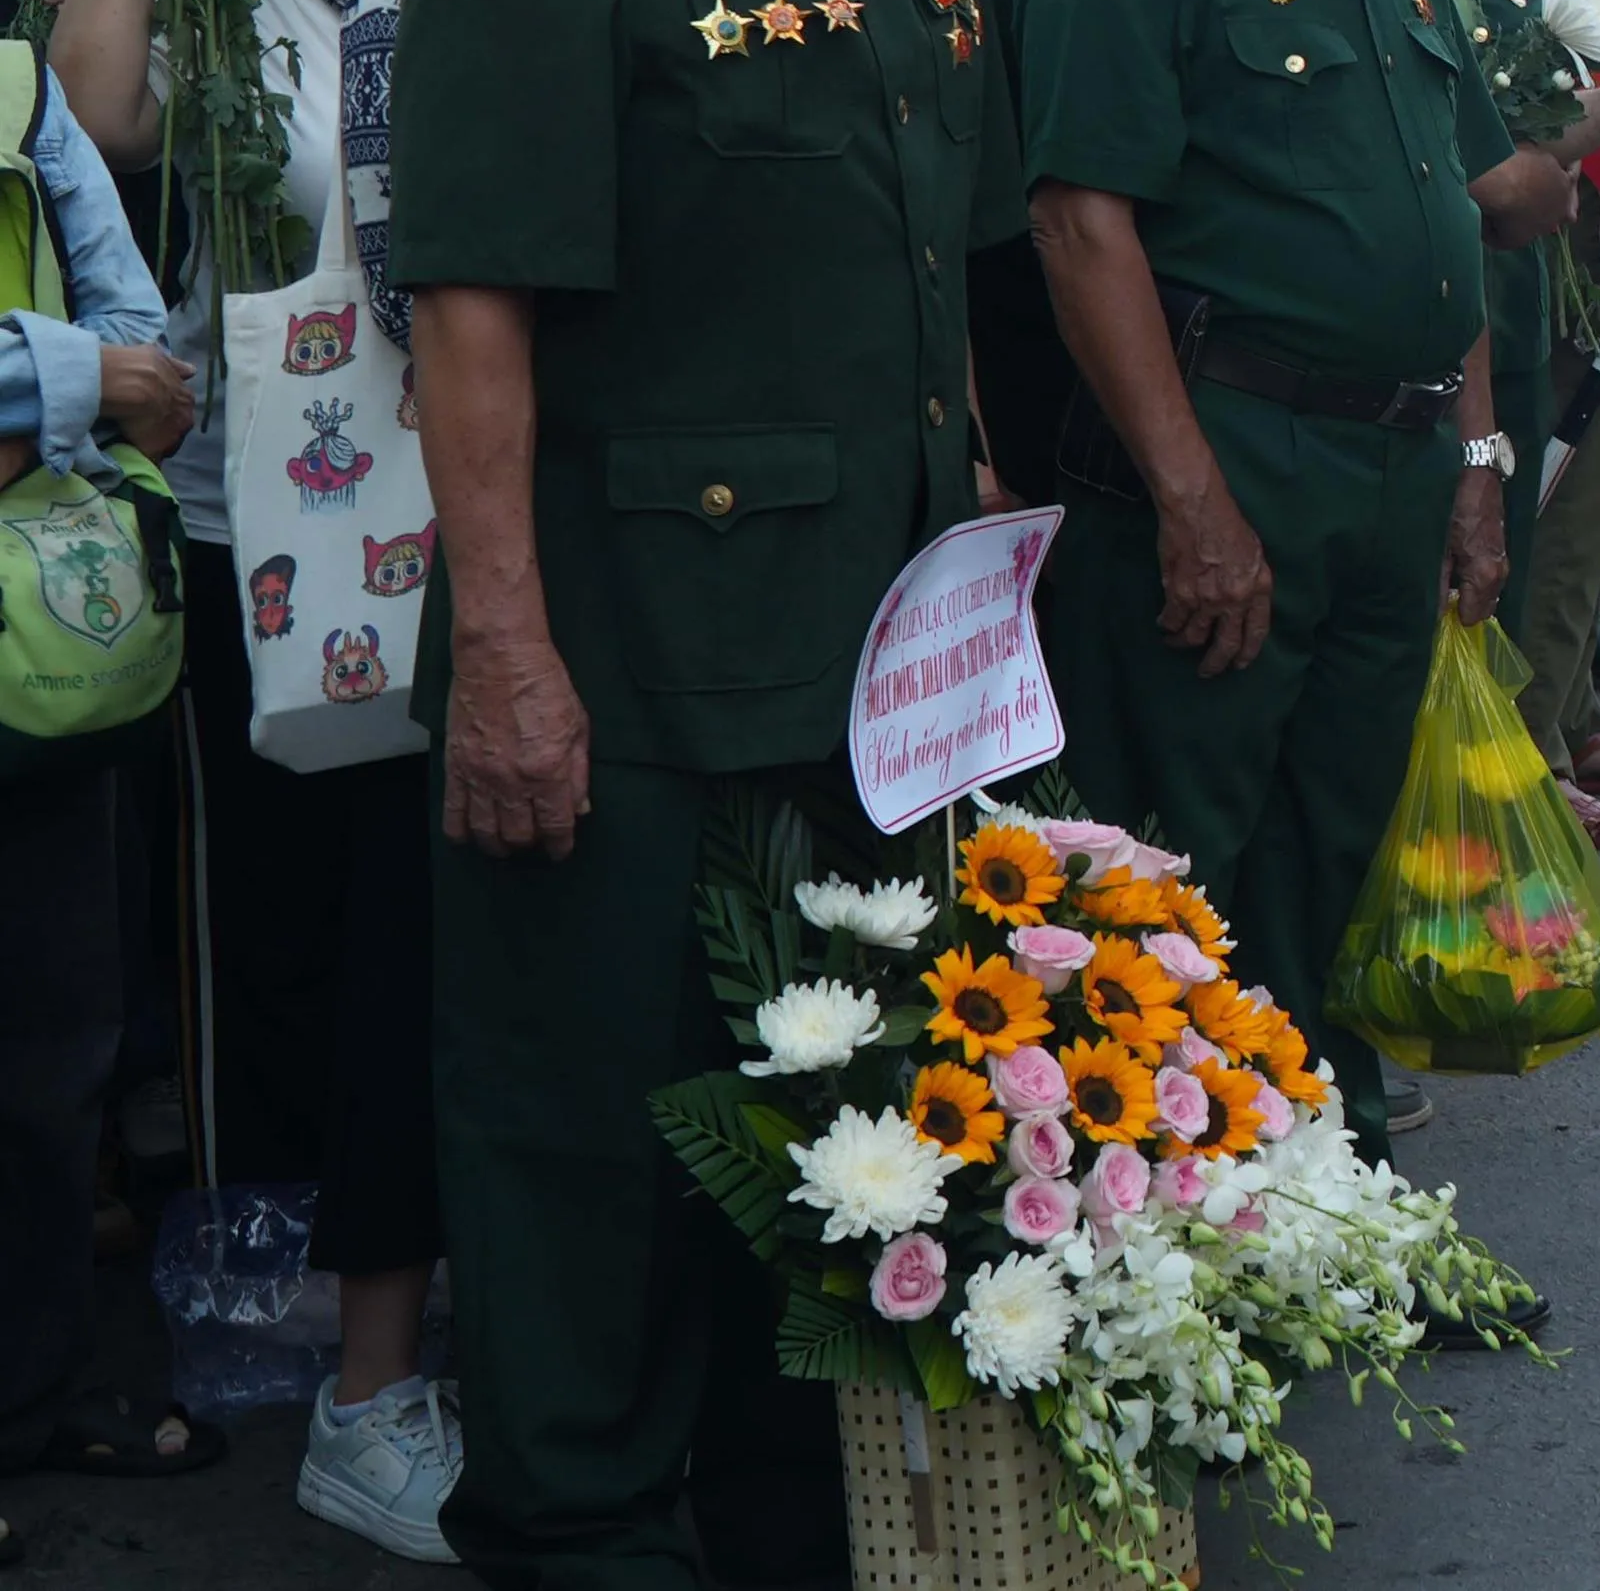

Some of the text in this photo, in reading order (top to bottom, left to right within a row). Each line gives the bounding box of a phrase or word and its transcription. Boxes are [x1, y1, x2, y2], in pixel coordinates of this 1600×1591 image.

[925, 594, 945, 638] LẠC
[864, 725, 910, 794] Kính
[914, 715, 954, 789] viếng
[1015, 675, 1040, 730] đội
